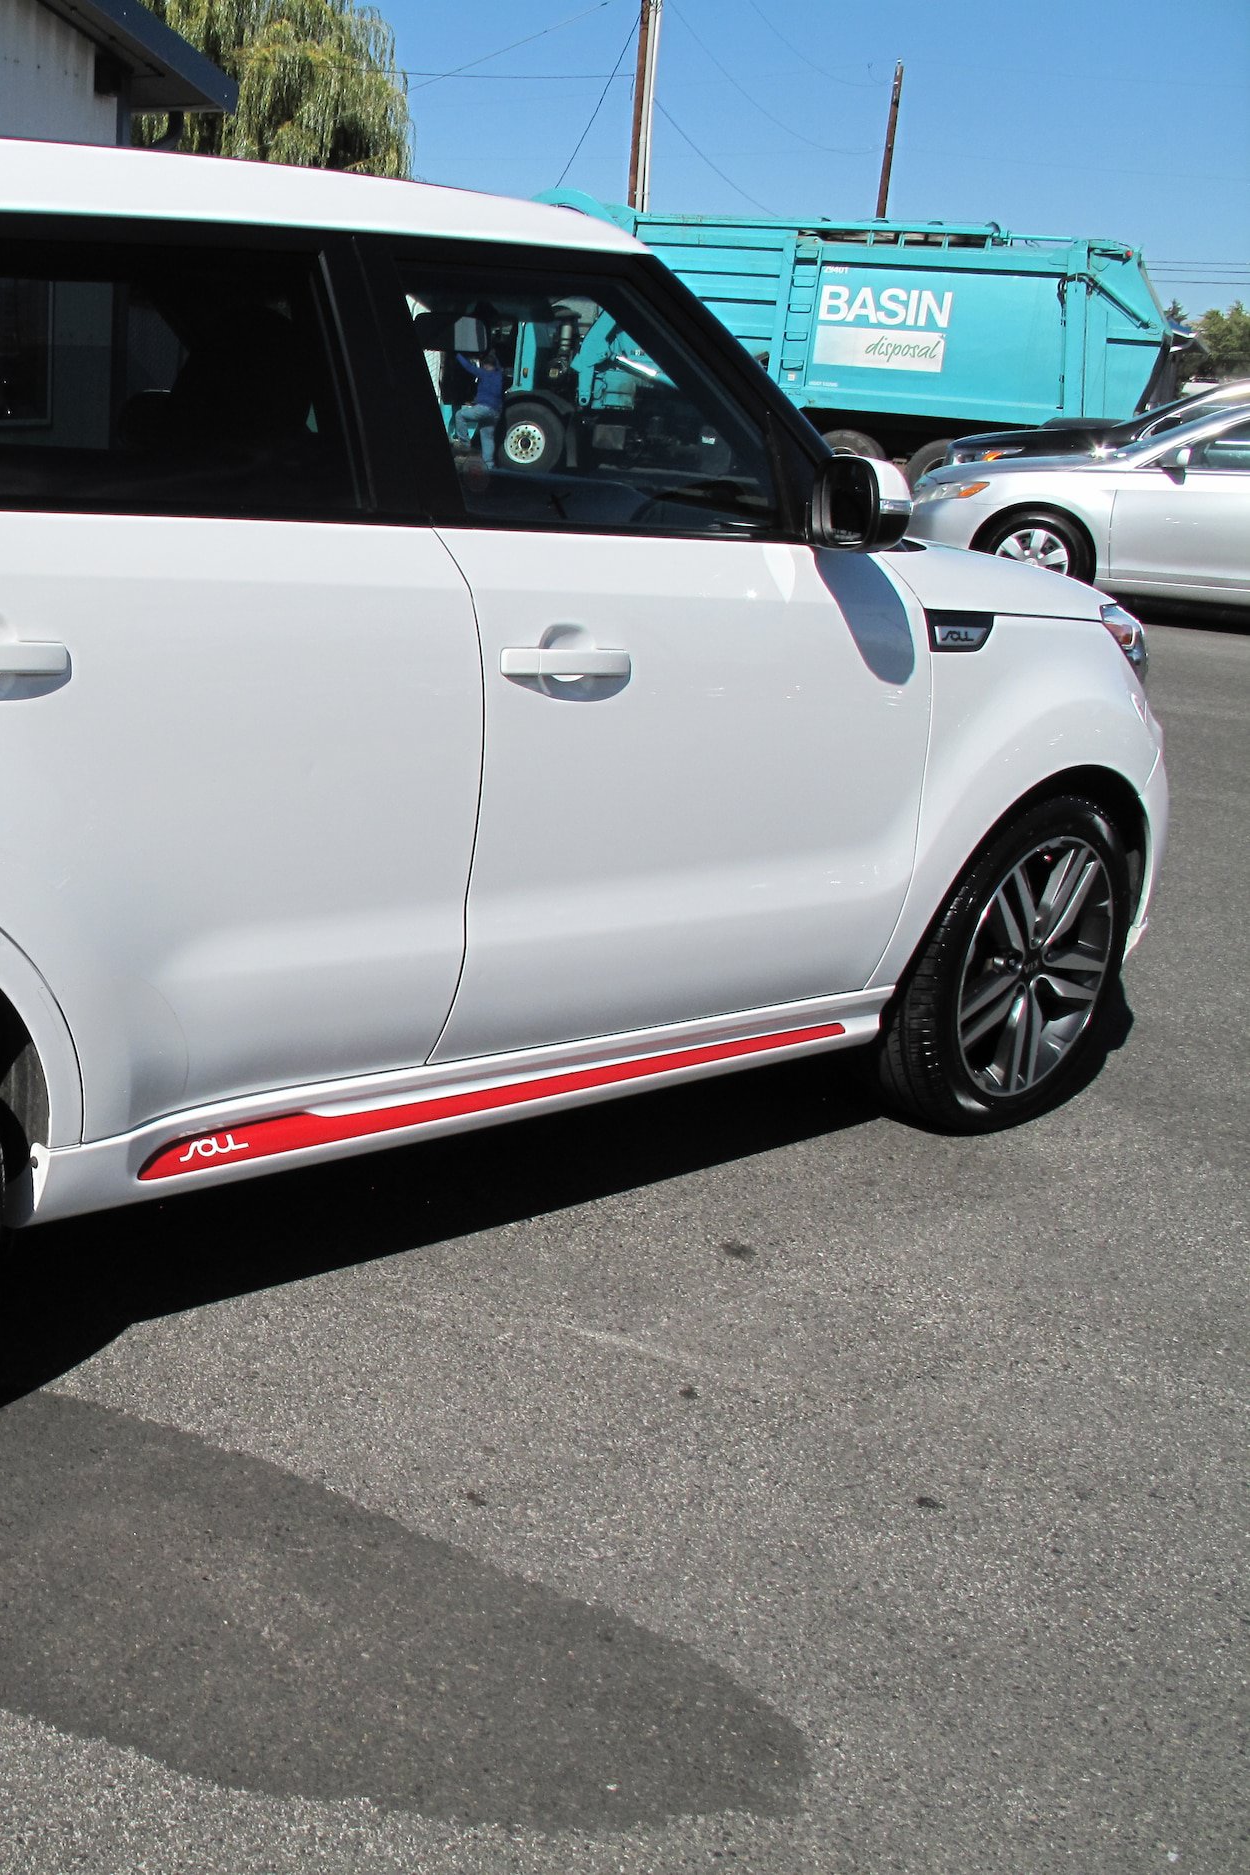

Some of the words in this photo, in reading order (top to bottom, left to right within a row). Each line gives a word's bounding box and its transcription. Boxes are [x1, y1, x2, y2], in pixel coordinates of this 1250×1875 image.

[818, 285, 953, 328] BASIN
[865, 336, 941, 363] disposal
[179, 1134, 250, 1163] SOUL
